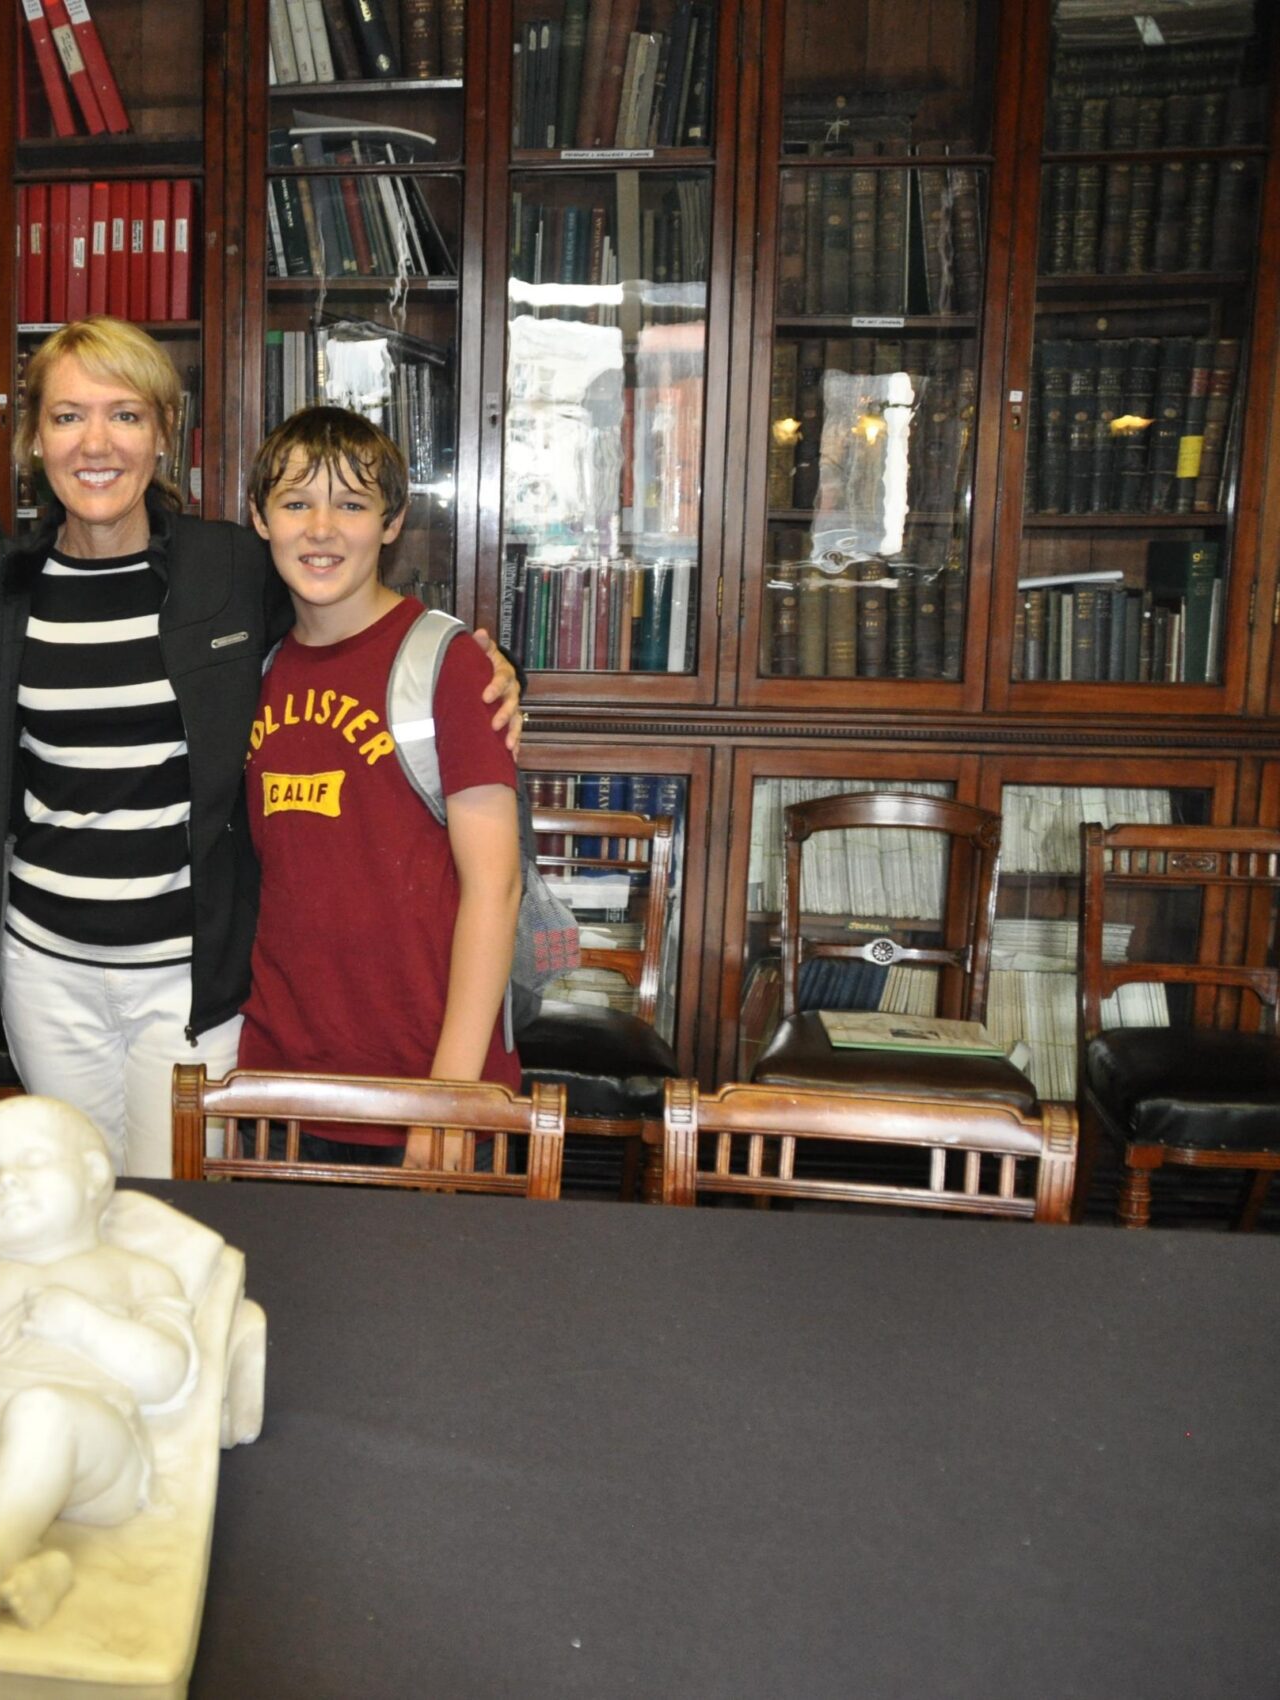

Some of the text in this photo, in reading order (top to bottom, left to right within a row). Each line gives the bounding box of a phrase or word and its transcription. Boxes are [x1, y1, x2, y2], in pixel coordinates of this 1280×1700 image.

[501, 615, 512, 650] DIRECTO
[246, 689, 396, 765] OLLISTER
[270, 783, 329, 803] CALIF
[599, 775, 610, 811] AYER
